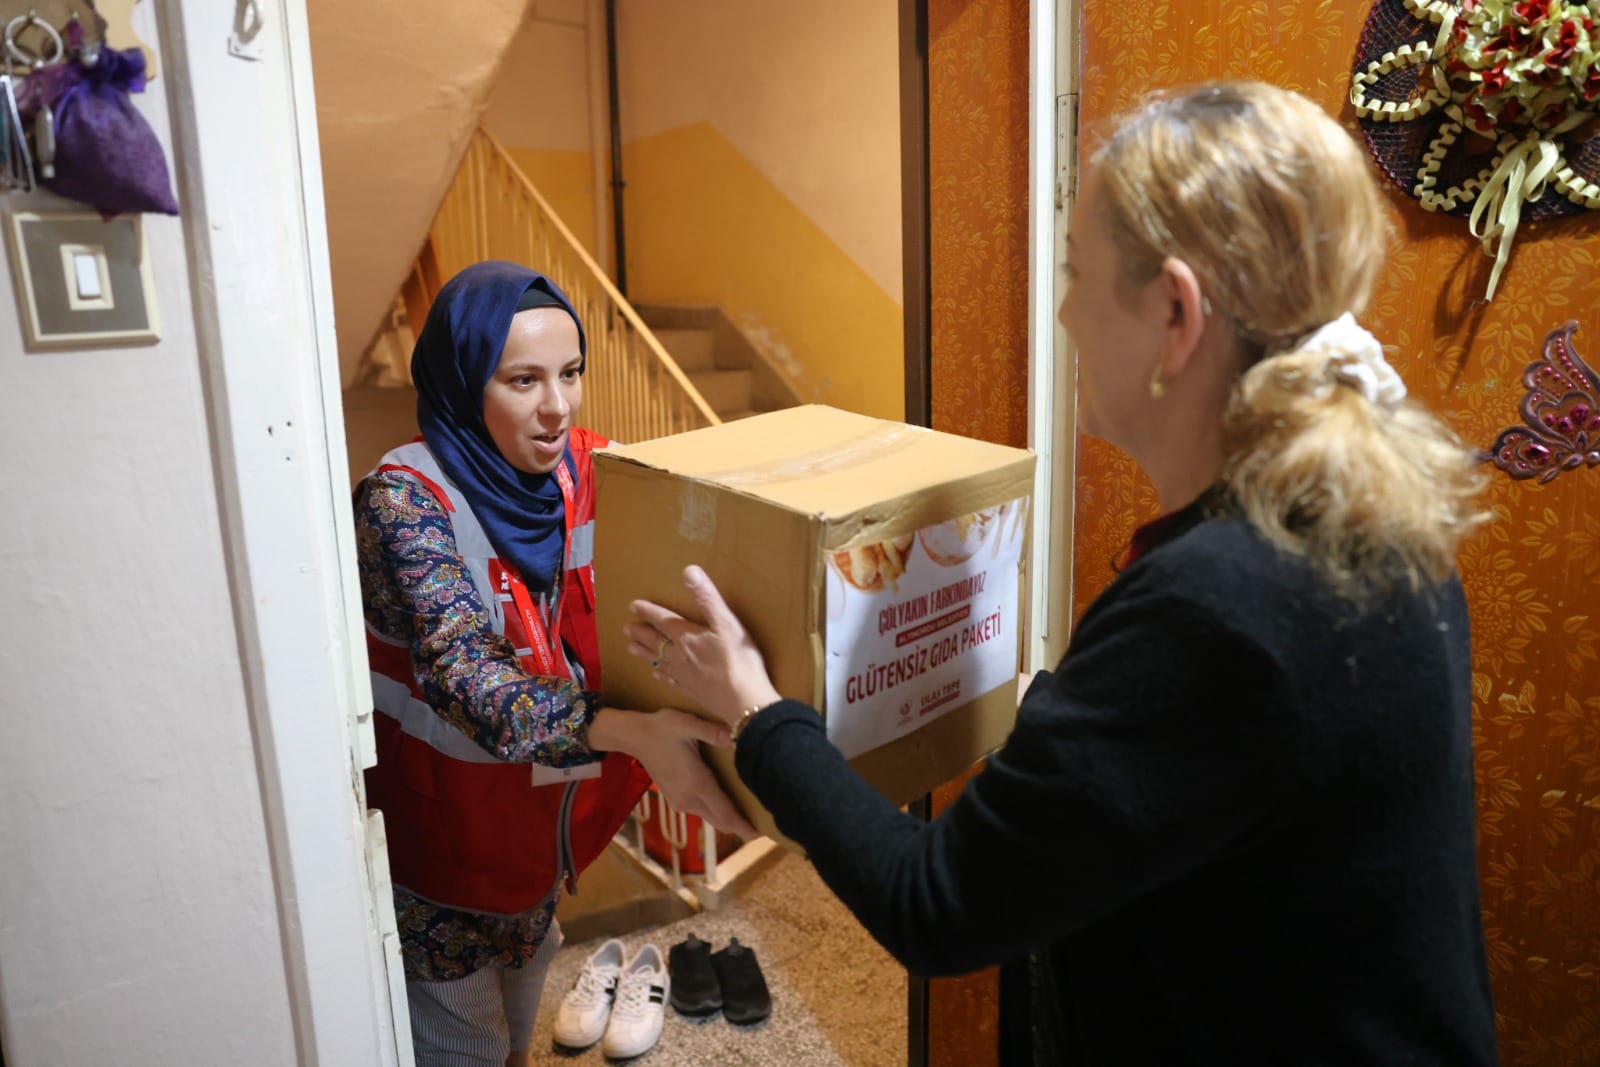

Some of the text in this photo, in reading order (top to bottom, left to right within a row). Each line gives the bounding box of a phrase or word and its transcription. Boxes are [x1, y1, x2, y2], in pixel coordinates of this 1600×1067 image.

[846, 645, 927, 704] GLÜTENSİZ
[930, 634, 957, 668] GIDA
[961, 605, 1001, 652] PAKETİ
